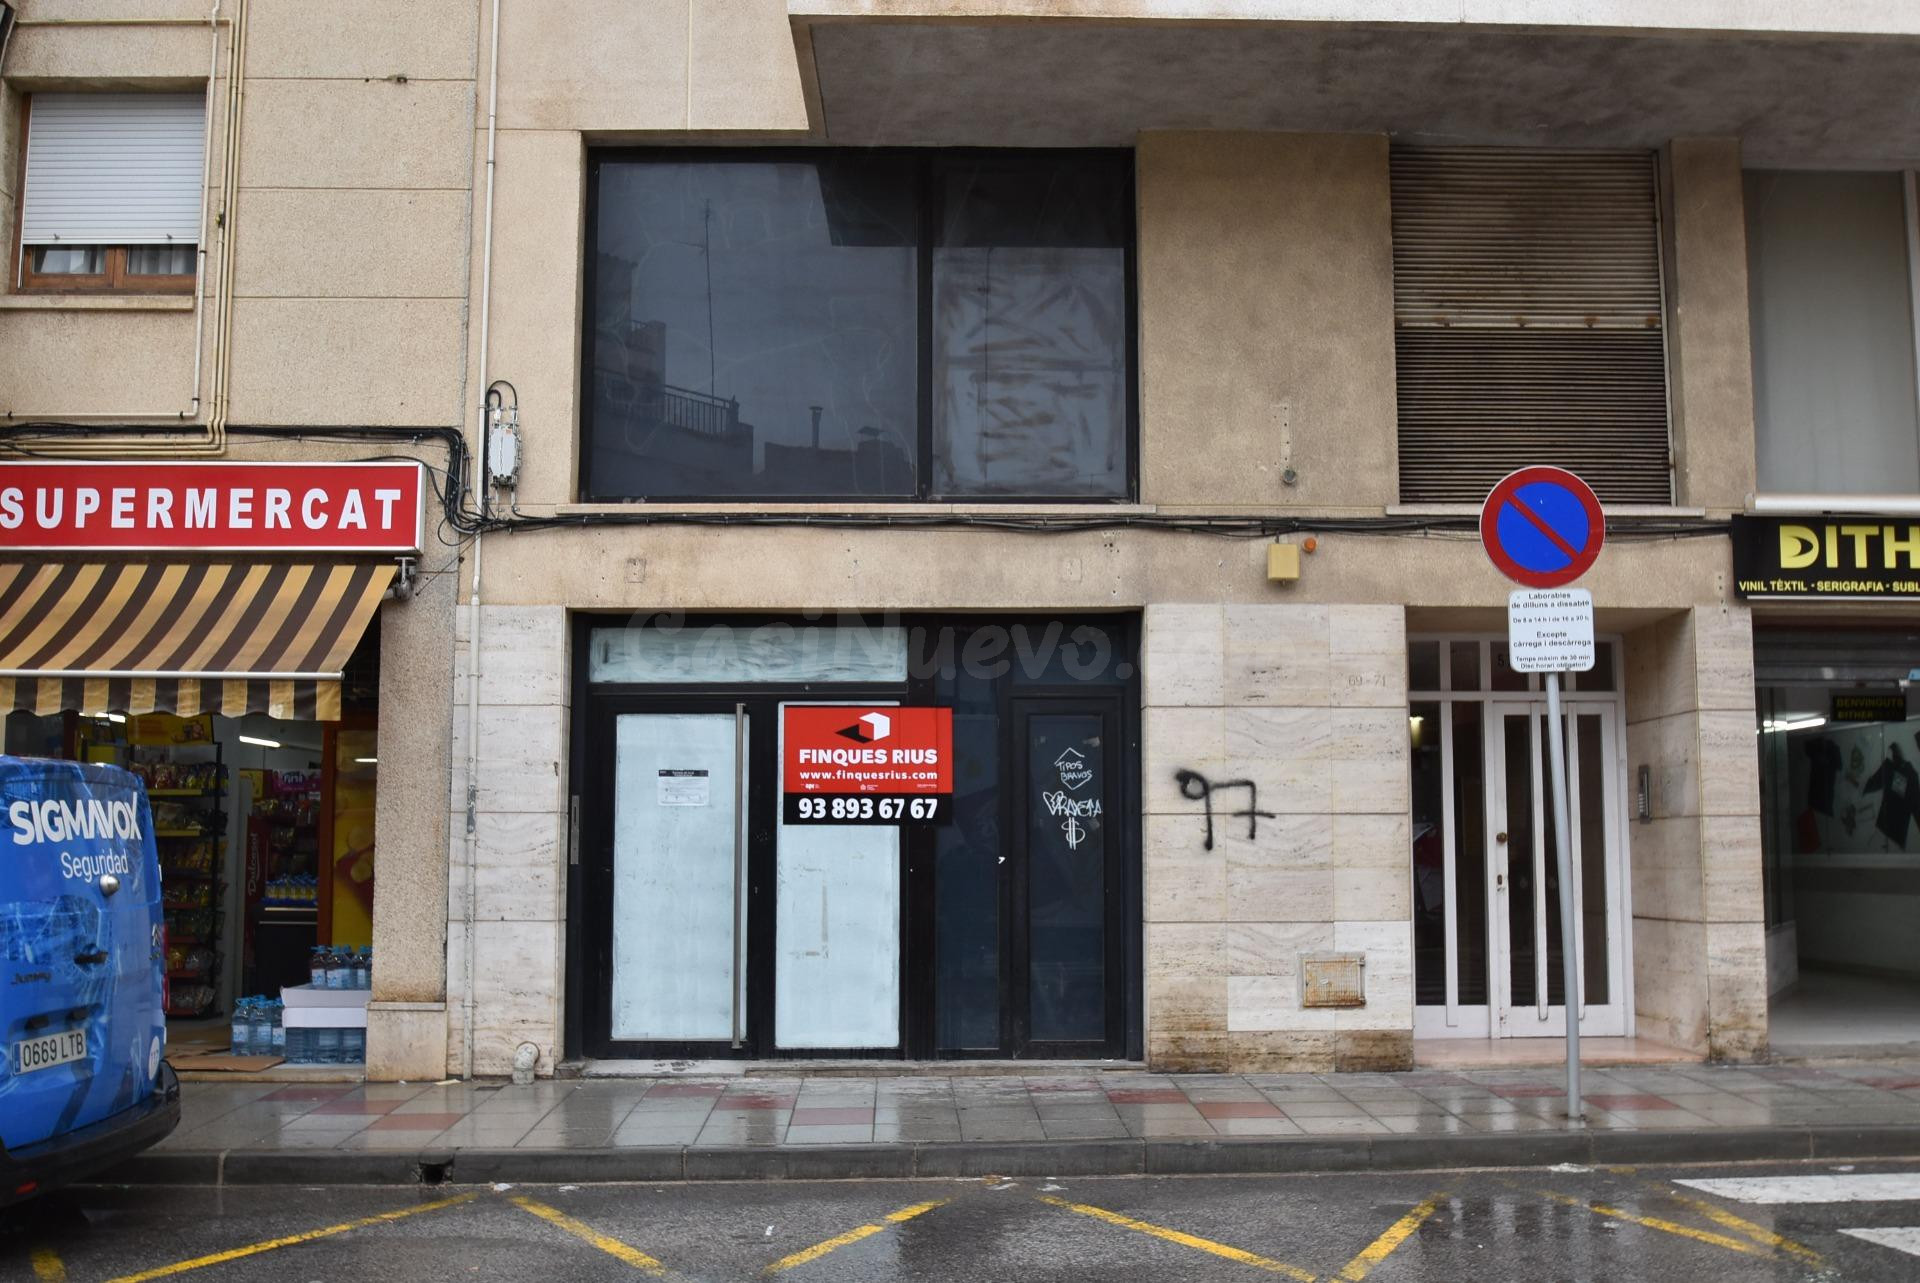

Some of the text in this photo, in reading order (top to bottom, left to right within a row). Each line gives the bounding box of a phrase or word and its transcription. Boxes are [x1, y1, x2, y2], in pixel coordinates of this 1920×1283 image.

[0, 487, 401, 529] SUPERMERCAT
[1779, 525, 1920, 569] DITH
[1739, 580, 1767, 592] VINIL
[1817, 580, 1884, 592] SERIGRAFIA
[1522, 601, 1548, 609] dilluns
[1556, 600, 1590, 608] dissabte
[1528, 592, 1571, 600] Laborables
[1536, 631, 1567, 639] Excepte
[799, 749, 938, 766] FINQUES RIUS
[799, 770, 938, 781] www.finquesrius.com
[798, 797, 938, 819] 93 893 67 67
[9, 791, 142, 846] SIGMAVOX
[61, 847, 129, 883] Seguridad
[23, 1032, 84, 1067] 0669 LTB
